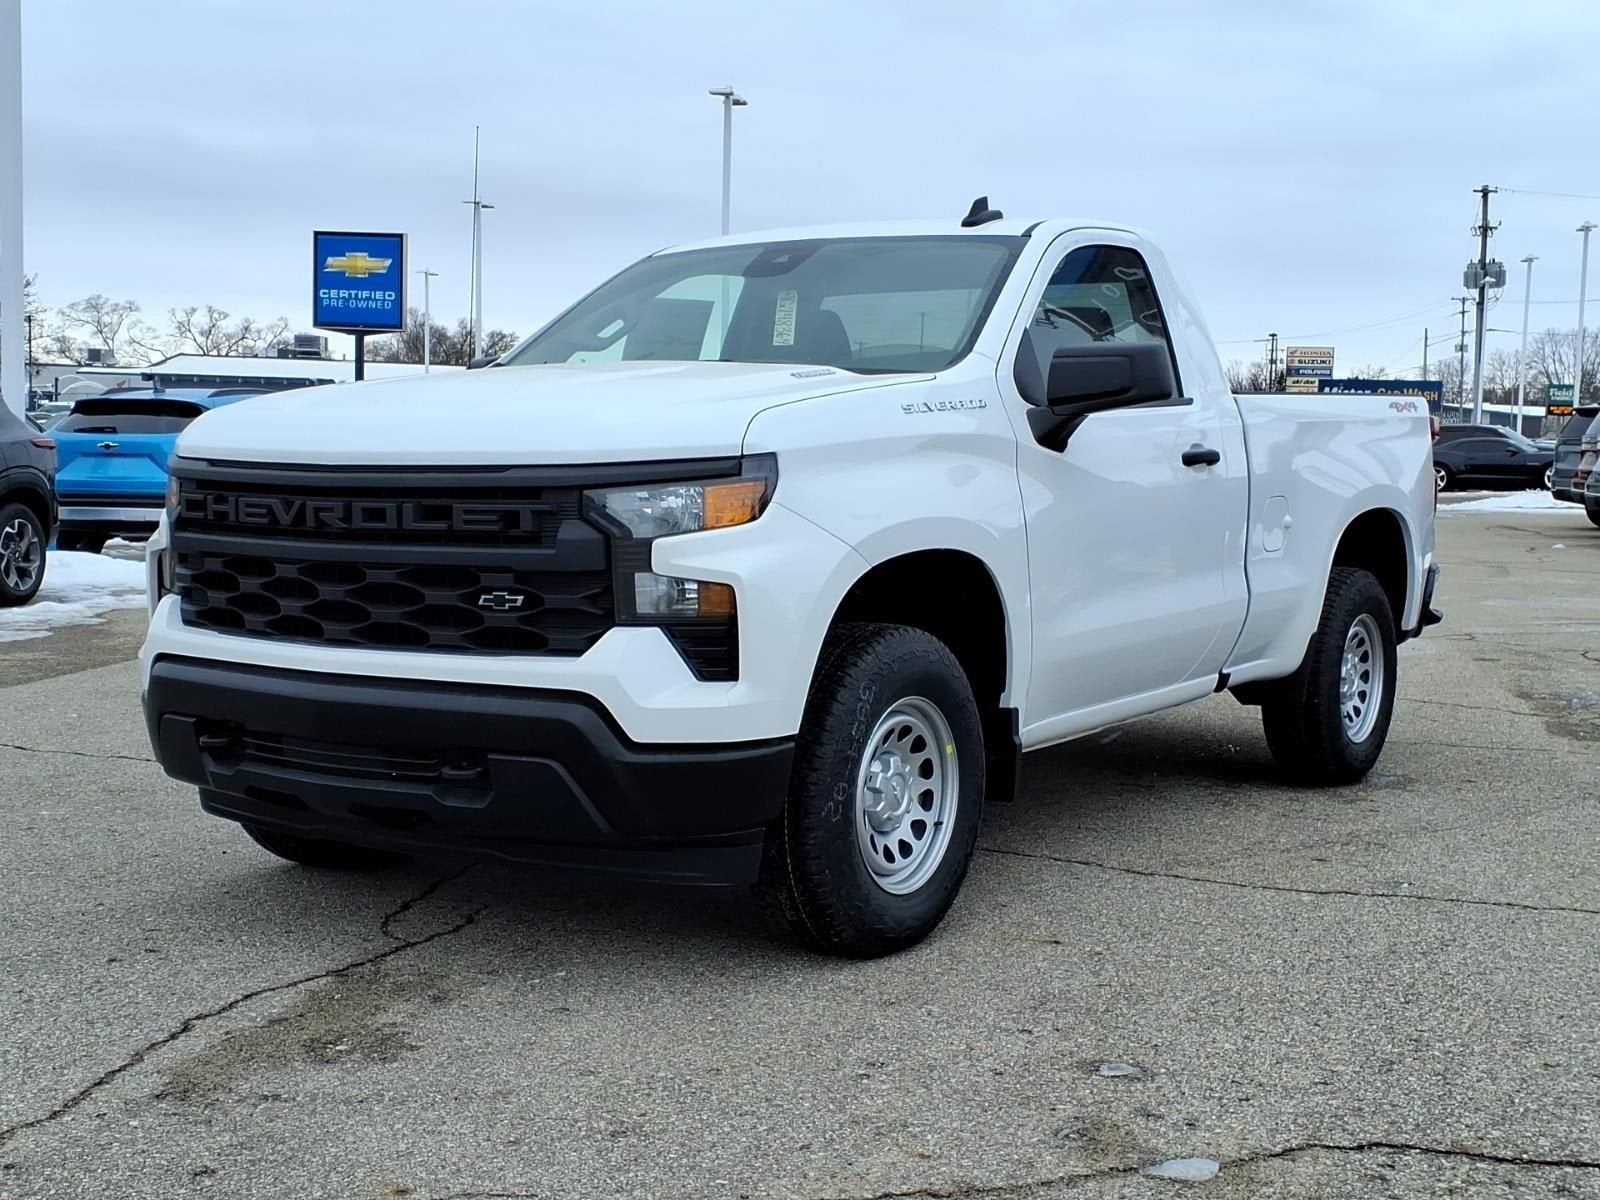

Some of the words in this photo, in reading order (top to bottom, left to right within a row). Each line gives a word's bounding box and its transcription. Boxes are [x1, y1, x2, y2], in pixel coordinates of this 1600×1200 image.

[319, 289, 396, 300] CERTIFIED
[323, 299, 392, 309] PRE-OWNED
[900, 399, 987, 414] SILVERADO
[179, 492, 555, 532] CHEVROLET
